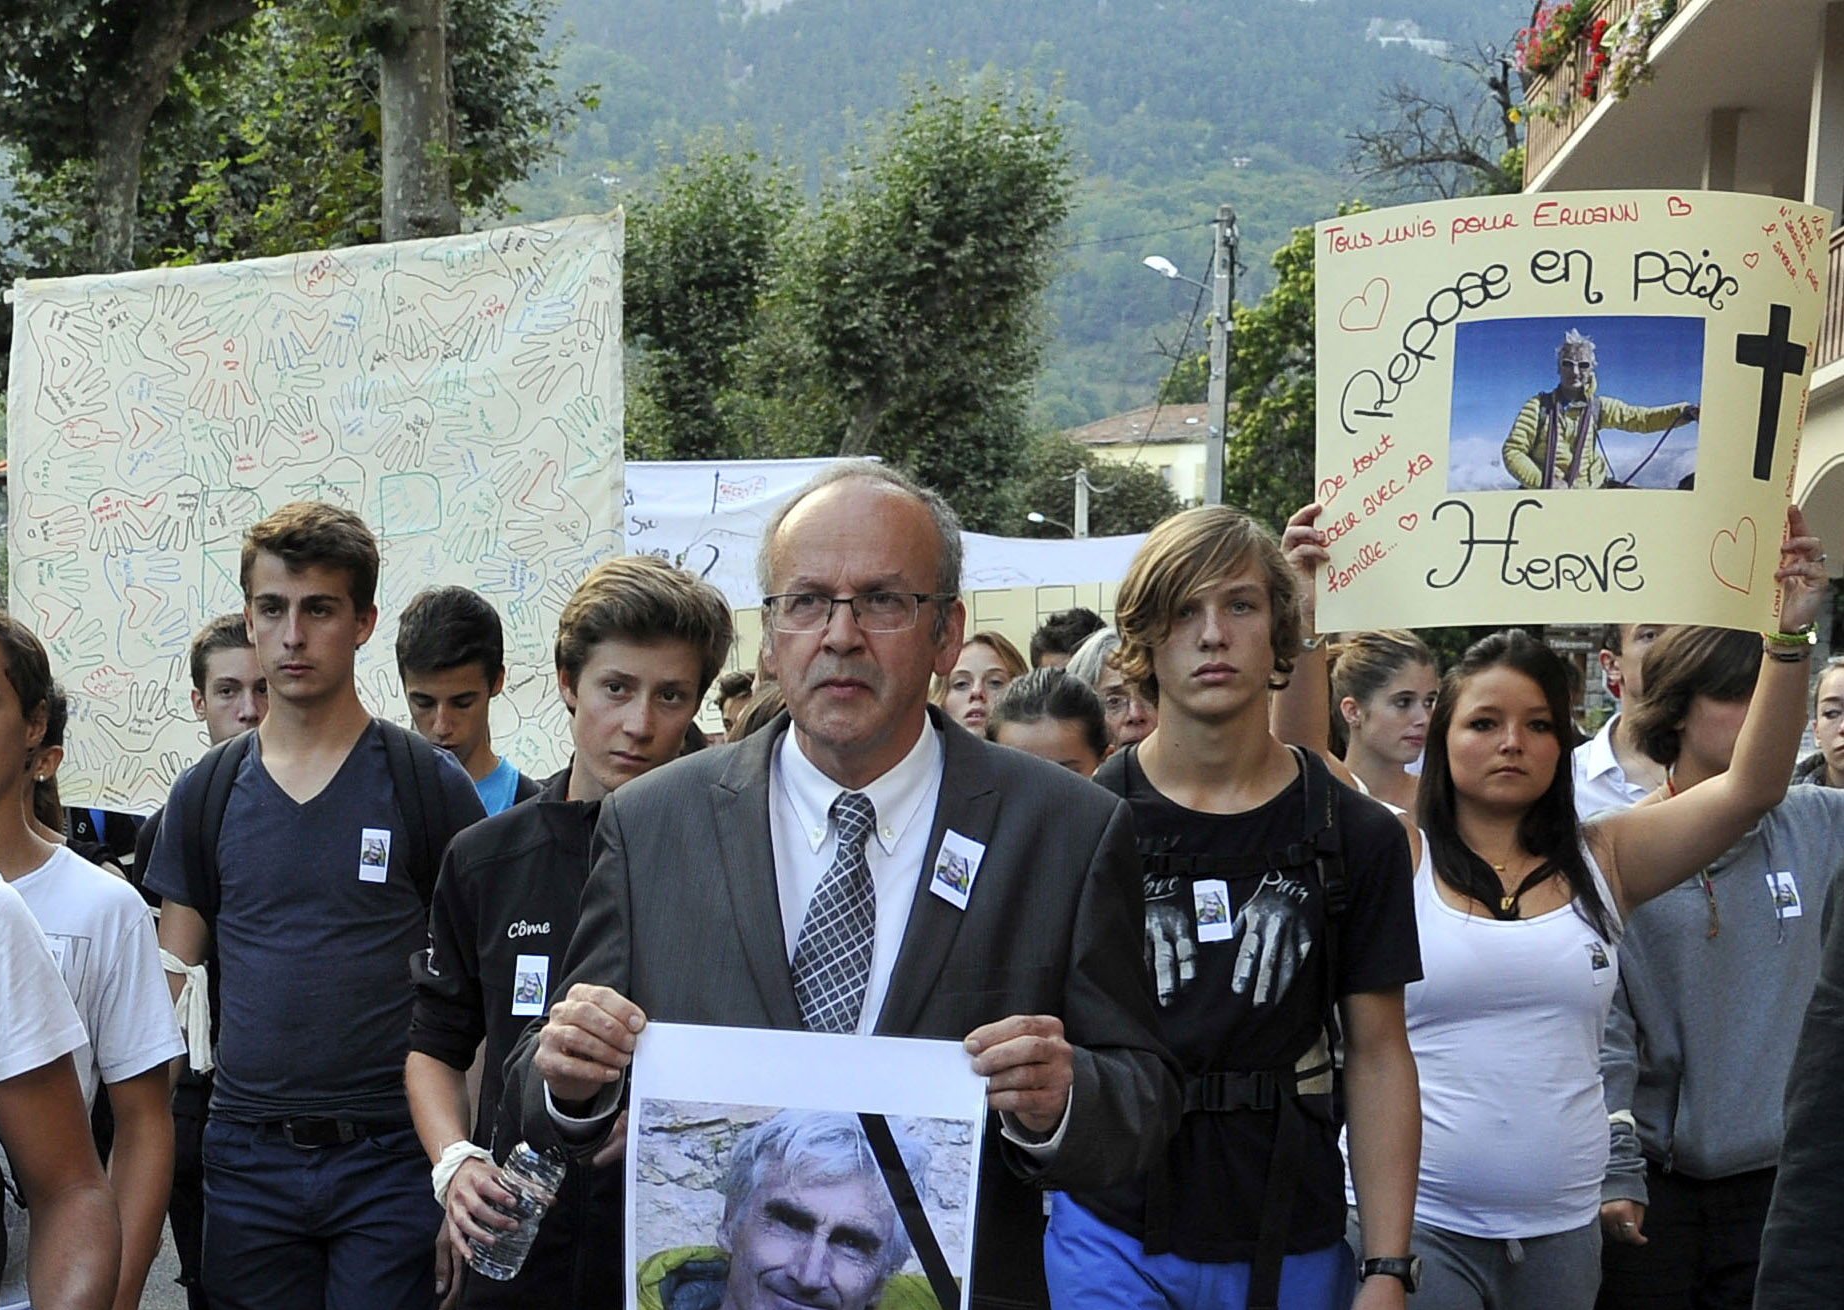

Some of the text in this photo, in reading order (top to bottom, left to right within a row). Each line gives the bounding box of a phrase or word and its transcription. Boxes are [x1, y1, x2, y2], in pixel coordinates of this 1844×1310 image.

[1340, 248, 1739, 435] Repose en paix
[1318, 434, 1395, 506] De tout
[1408, 453, 1433, 483] ta
[507, 919, 551, 939] Côme
